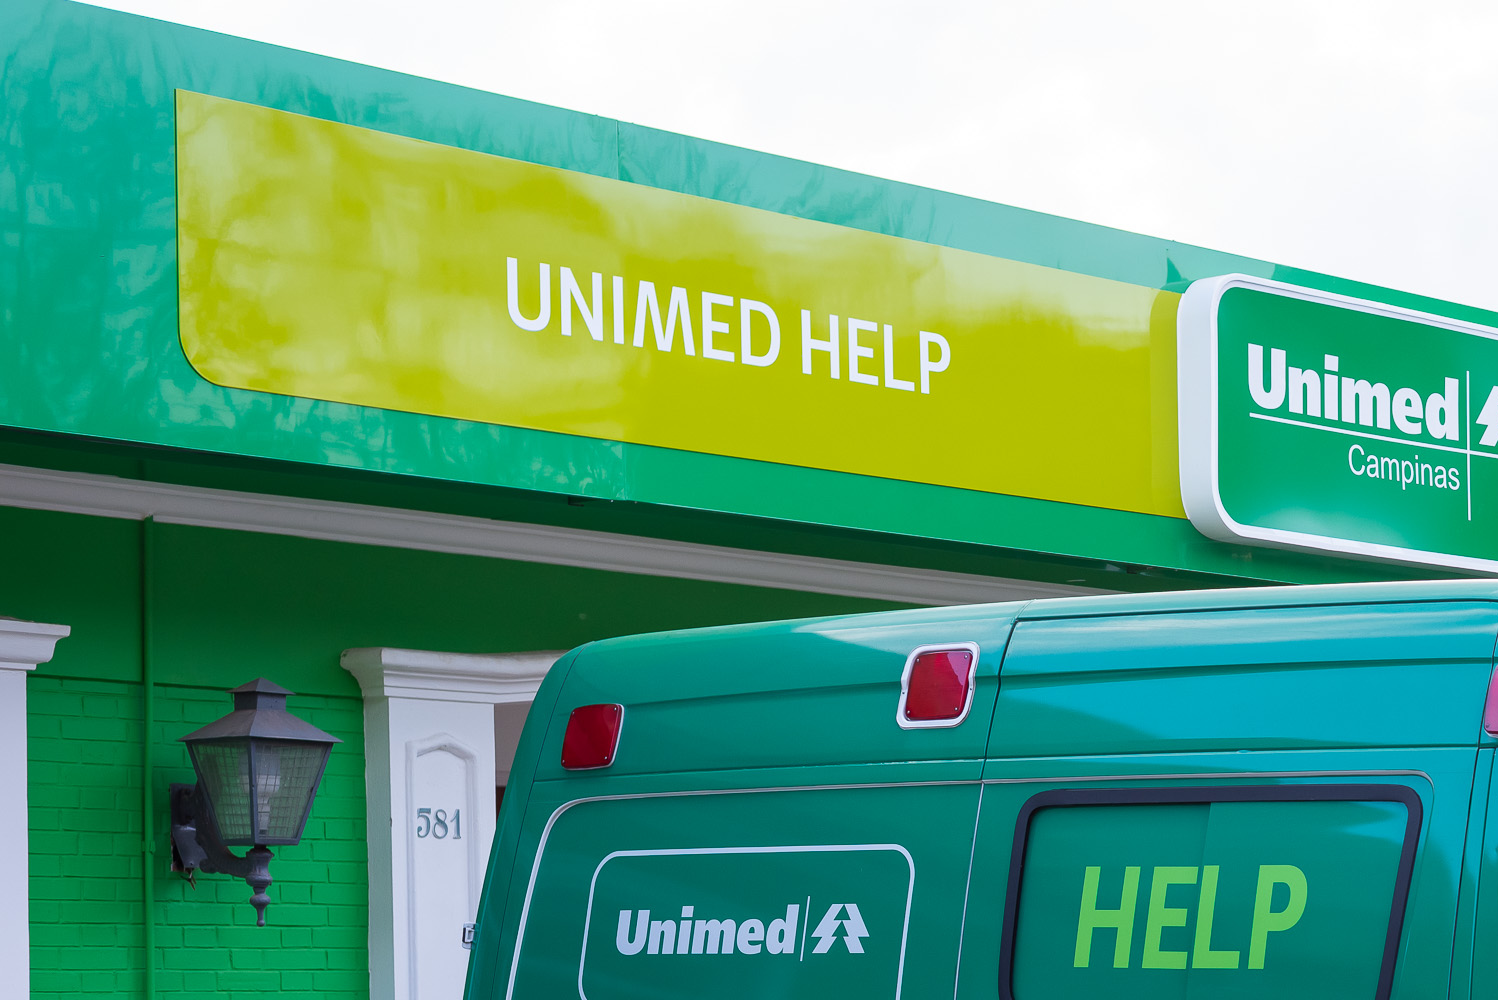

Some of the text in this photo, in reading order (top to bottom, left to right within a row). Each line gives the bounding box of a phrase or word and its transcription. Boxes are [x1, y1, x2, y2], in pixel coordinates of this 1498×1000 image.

[506, 256, 952, 394] UNIMED HELP
[1247, 342, 1460, 441] Unimed
[1348, 444, 1461, 490] Campinas
[416, 807, 462, 840] 581
[615, 903, 800, 956] Unimed
[1073, 864, 1308, 970] HELP
